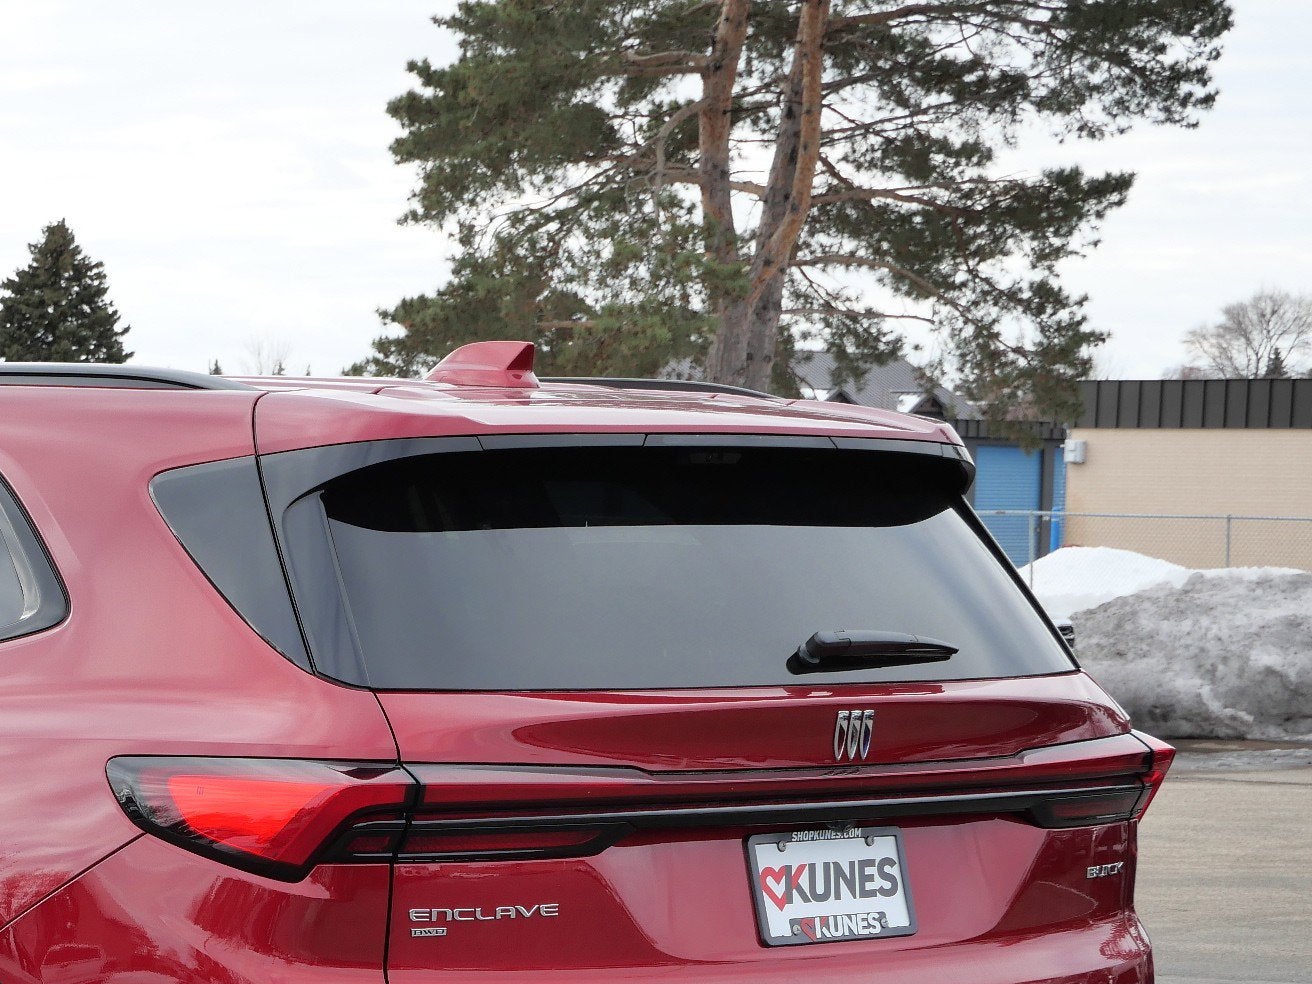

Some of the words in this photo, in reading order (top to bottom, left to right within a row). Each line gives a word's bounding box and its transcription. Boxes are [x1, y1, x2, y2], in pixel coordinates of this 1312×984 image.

[791, 828, 862, 842] SHOPKUNES.COM
[1087, 861, 1124, 879] BUICK
[785, 857, 899, 904] KUNES
[409, 903, 560, 922] ENCLAVE
[815, 912, 881, 939] KUNES
